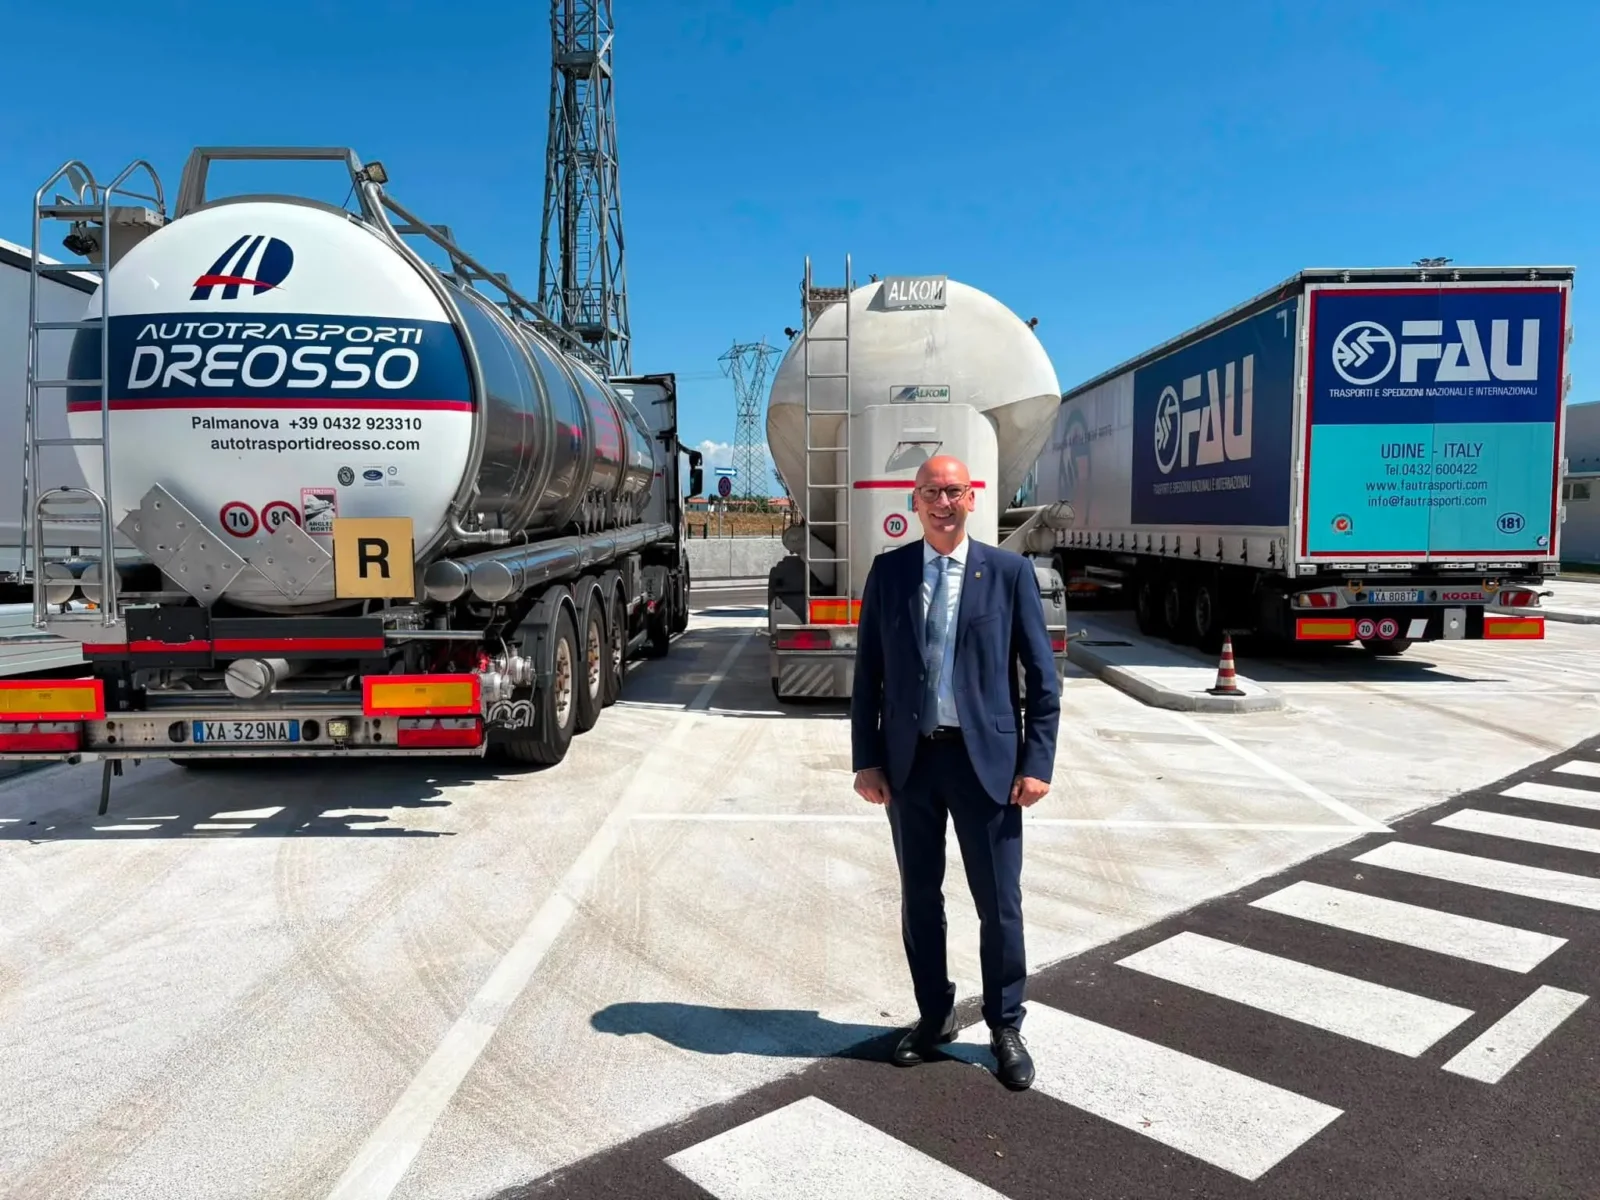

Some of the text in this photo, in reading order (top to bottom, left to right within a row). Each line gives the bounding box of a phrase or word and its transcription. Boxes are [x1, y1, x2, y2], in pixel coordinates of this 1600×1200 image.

[888, 280, 944, 301] ALKOM
[136, 322, 423, 345] AUTOTRASPORTI
[1400, 318, 1540, 383] FAU
[126, 344, 420, 390] DREOSSO
[1329, 386, 1538, 398] TRASPORTI E SPEDIZIONI NAZIONALI E INTERNAZIONALI
[1181, 353, 1254, 468] FAU
[192, 416, 422, 430] Palmanova +39 0432 923310
[210, 437, 420, 453] autotrasportidreosso.com
[1380, 443, 1425, 459] UDINE
[1443, 443, 1484, 458] ITALY
[1435, 463, 1478, 475] 600422
[1365, 480, 1488, 492] www.fautrasporti.com
[1368, 495, 1487, 507] info@fautrasporti.com
[229, 511, 249, 527] 70
[890, 520, 901, 531] 70
[1500, 517, 1521, 529] 181
[357, 537, 391, 579] R
[1374, 592, 1417, 602] XA 808TP
[1361, 624, 1371, 633] 70
[1382, 624, 1393, 633] 80
[205, 721, 226, 740] XA
[233, 721, 288, 740] 329NA
